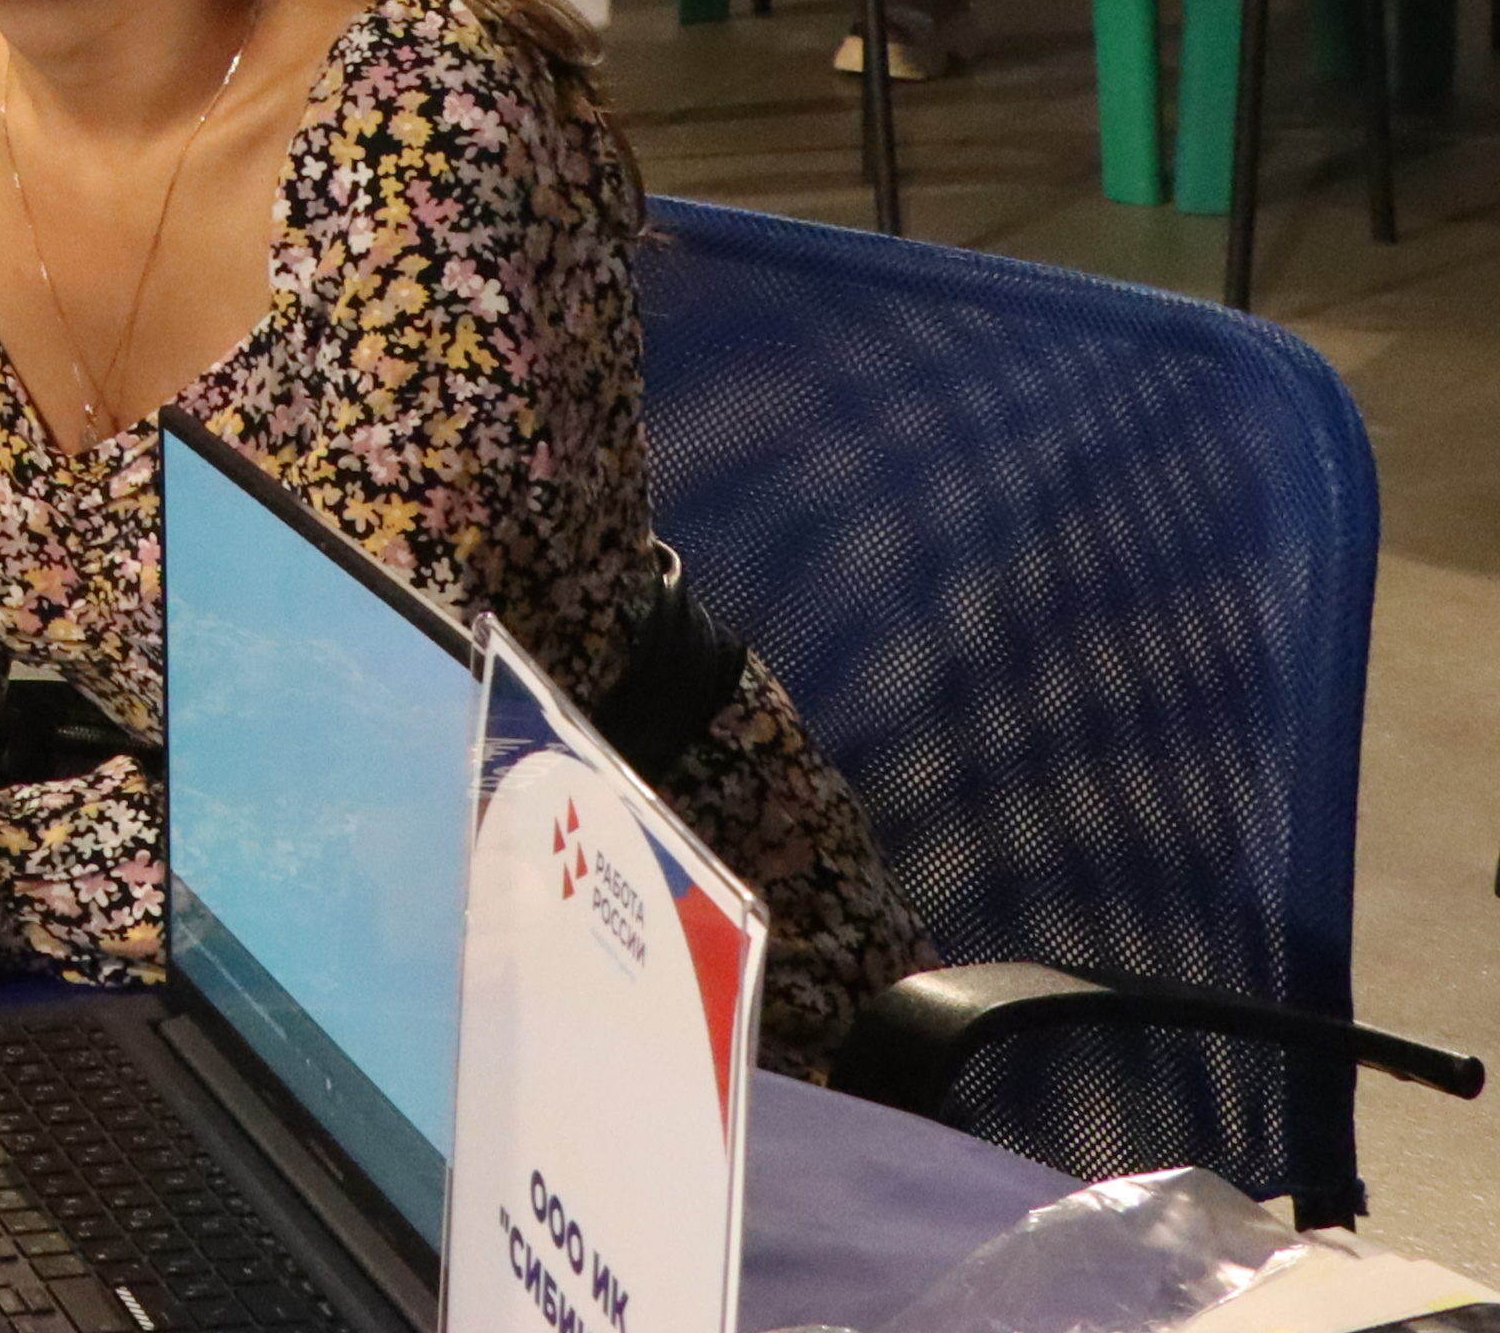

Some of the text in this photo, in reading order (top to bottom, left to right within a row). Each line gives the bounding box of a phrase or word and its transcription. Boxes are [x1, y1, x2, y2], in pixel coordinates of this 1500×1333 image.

[592, 885, 646, 969] РОССИИ
[595, 849, 645, 931] РАБОТА
[500, 1204, 585, 1333] "СИБИ
[530, 1169, 629, 1333] ООО ИК
